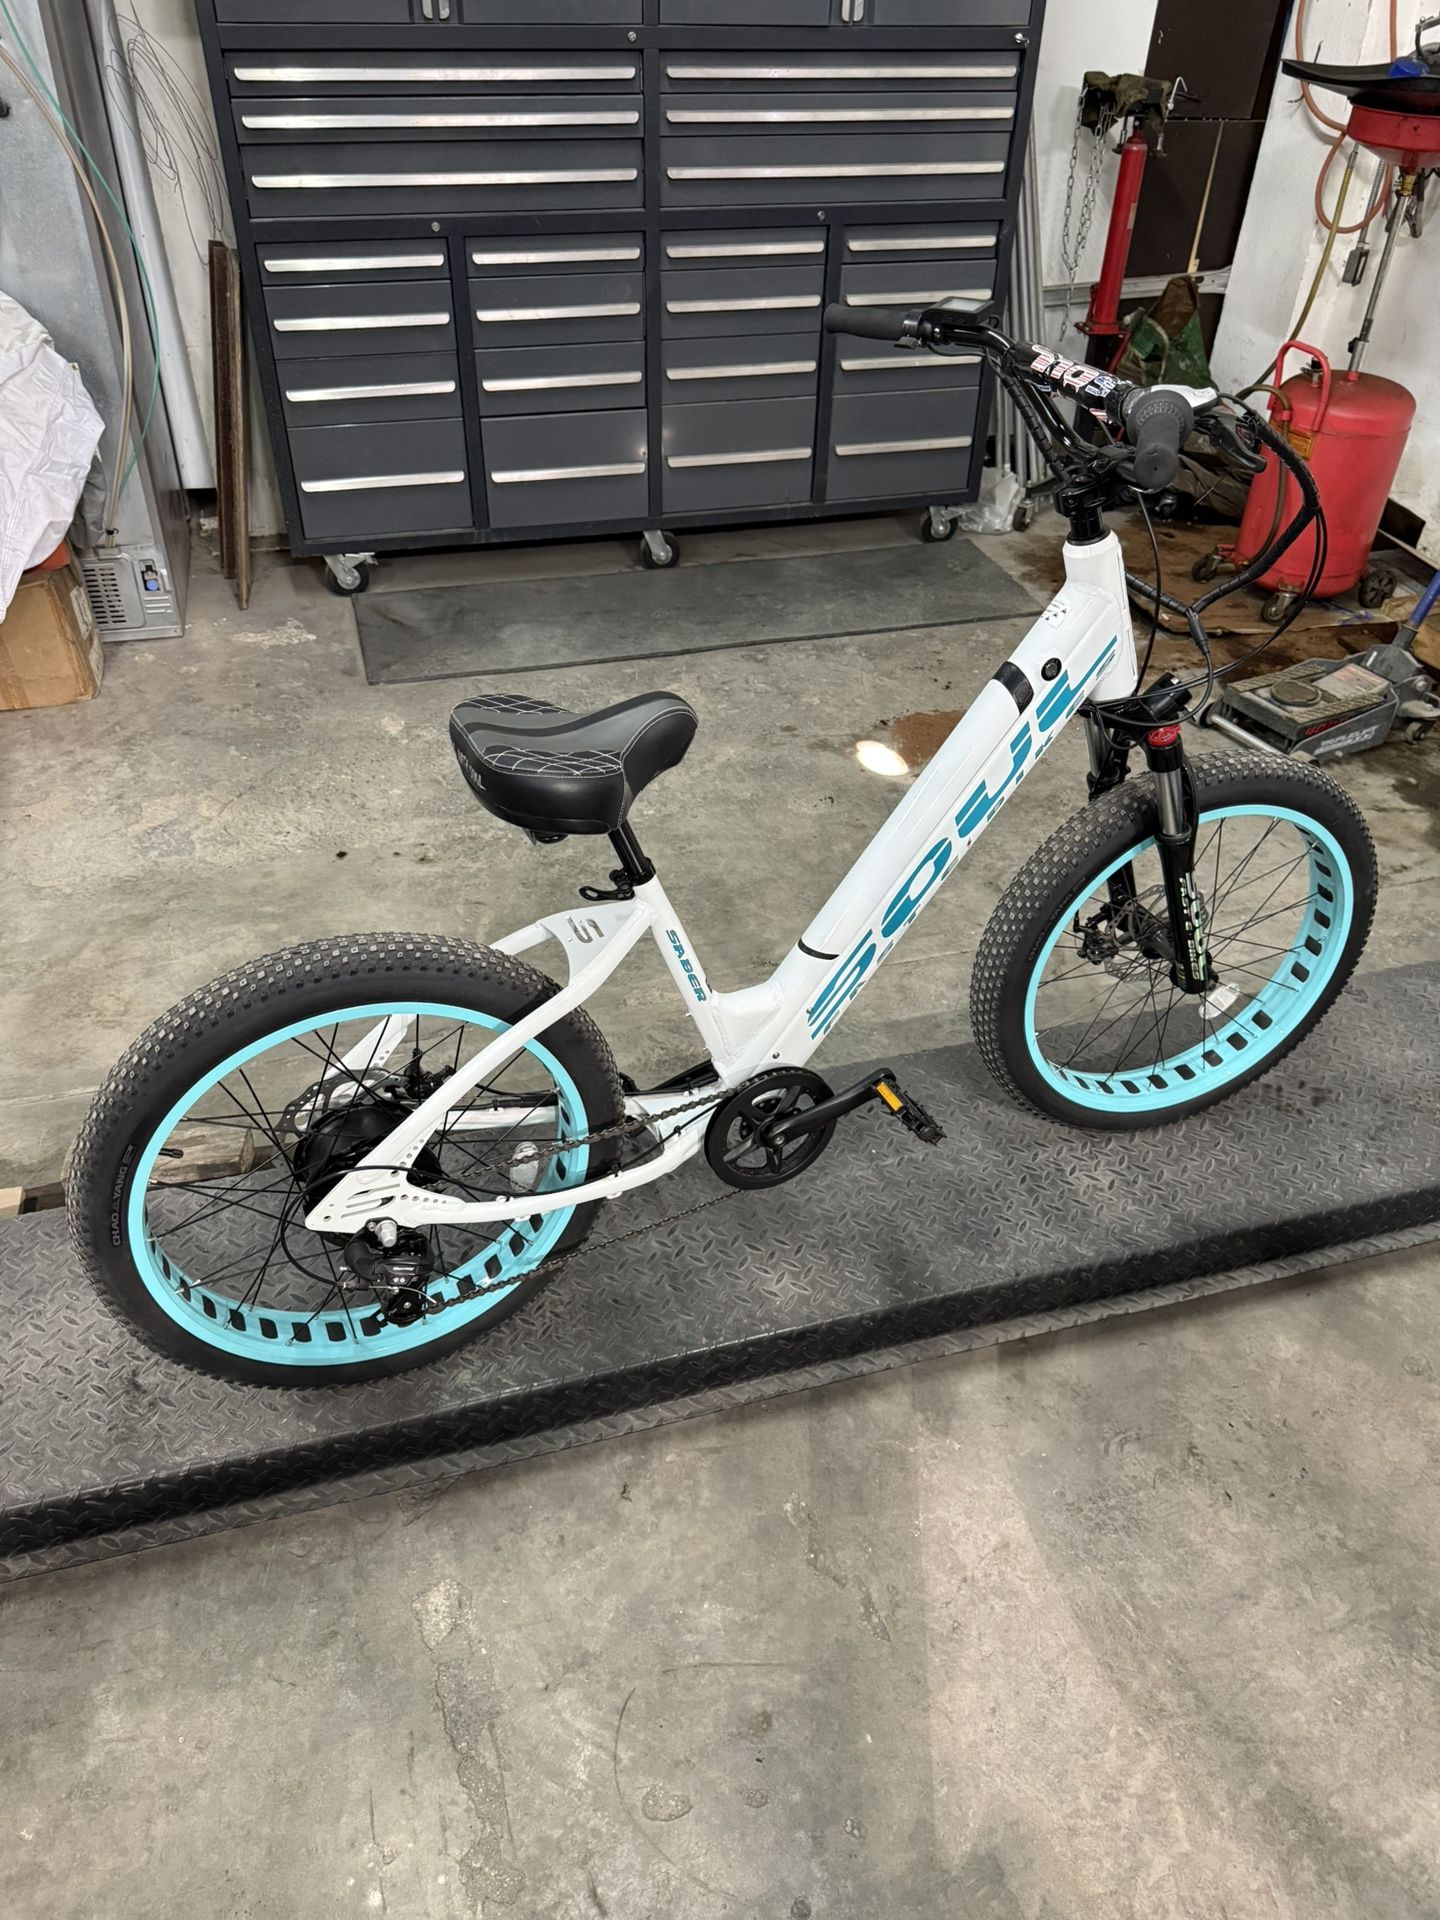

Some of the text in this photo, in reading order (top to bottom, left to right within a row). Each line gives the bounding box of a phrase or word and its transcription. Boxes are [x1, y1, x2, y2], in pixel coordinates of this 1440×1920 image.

[807, 635, 1118, 1041] SOUL
[665, 929, 707, 1003] SABER
[113, 1166, 129, 1200] YANG
